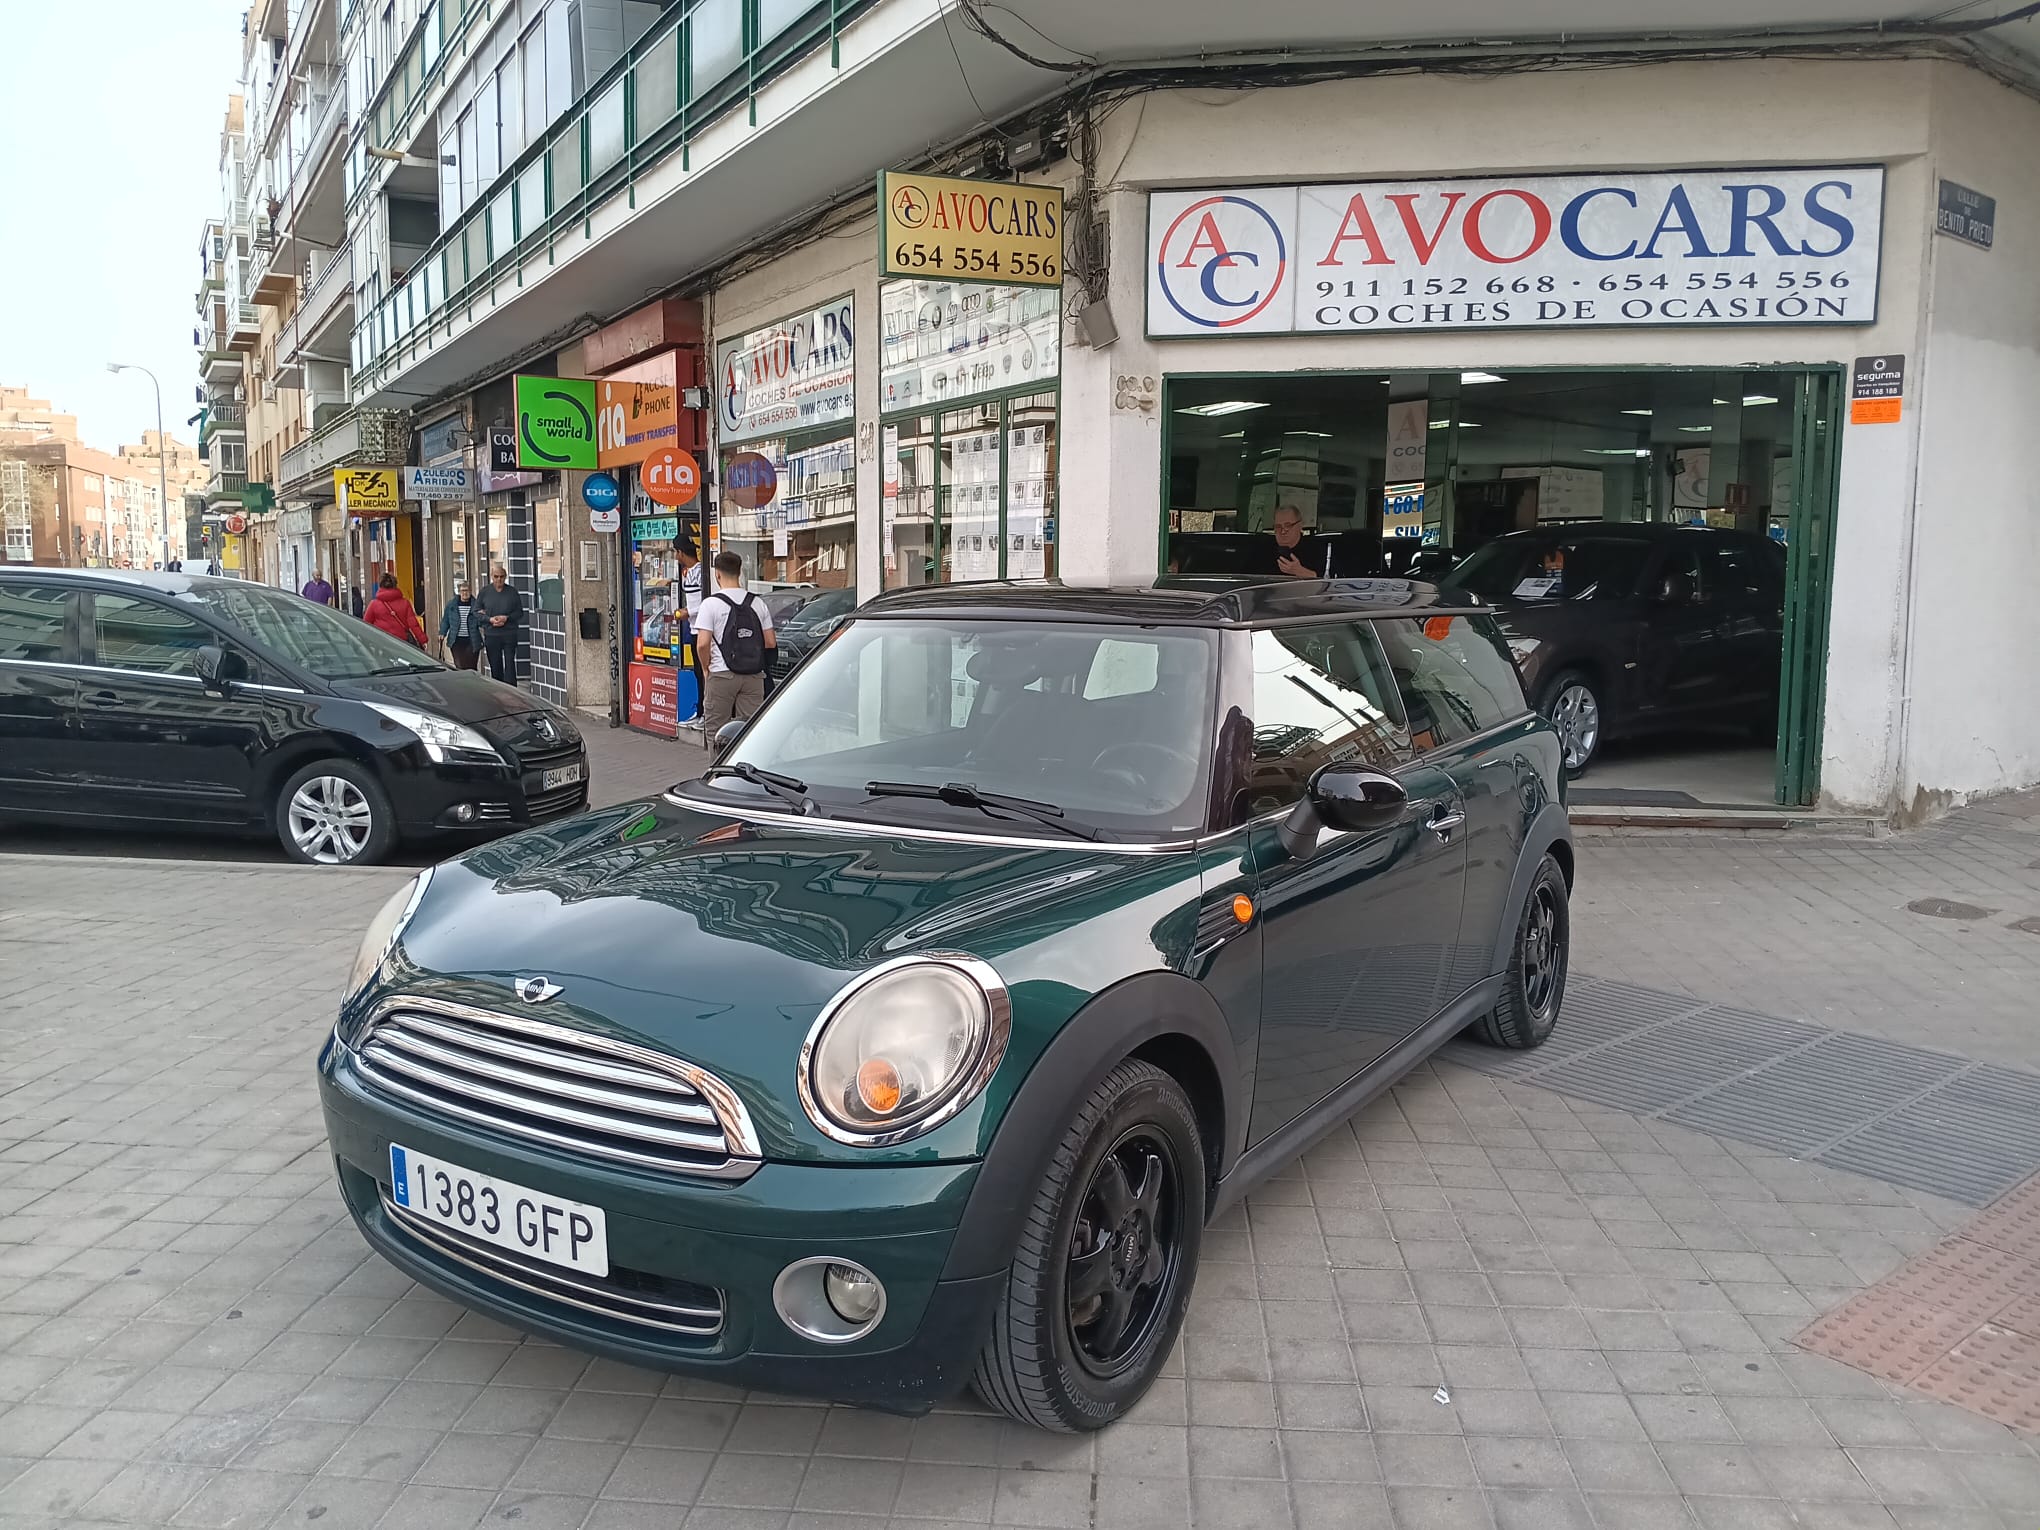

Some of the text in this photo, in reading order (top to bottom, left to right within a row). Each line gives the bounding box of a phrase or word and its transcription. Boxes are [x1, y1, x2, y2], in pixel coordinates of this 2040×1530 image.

[1958, 190, 1979, 208] CALLE
[932, 189, 1056, 239] AVOCARS
[1316, 181, 1855, 266] AVOCARS
[1939, 208, 1993, 243] BENITO PRIETO
[895, 242, 1056, 277] 654 554 556
[1316, 280, 1380, 299] 911
[1403, 278, 1468, 296] 152
[1485, 275, 1555, 294] 668
[1598, 273, 1669, 291] 654
[1686, 272, 1758, 290] 554
[1775, 270, 1850, 289] 556
[1315, 292, 1849, 325] COCHES DE OCASIÓN
[749, 305, 853, 386] AVOCARS
[1857, 372, 1901, 381] segurma
[598, 383, 626, 452] ria
[645, 396, 671, 415] PHONE
[536, 416, 571, 428] small
[547, 427, 583, 439] world
[647, 424, 676, 440] TRANSFER
[500, 453, 516, 464] BA
[649, 455, 694, 484] ria
[586, 488, 618, 496] DIGI
[650, 487, 670, 495] Money
[397, 1182, 405, 1196] E
[416, 1163, 594, 1262] 1383 GFP
[1125, 1235, 1135, 1262] MINI
